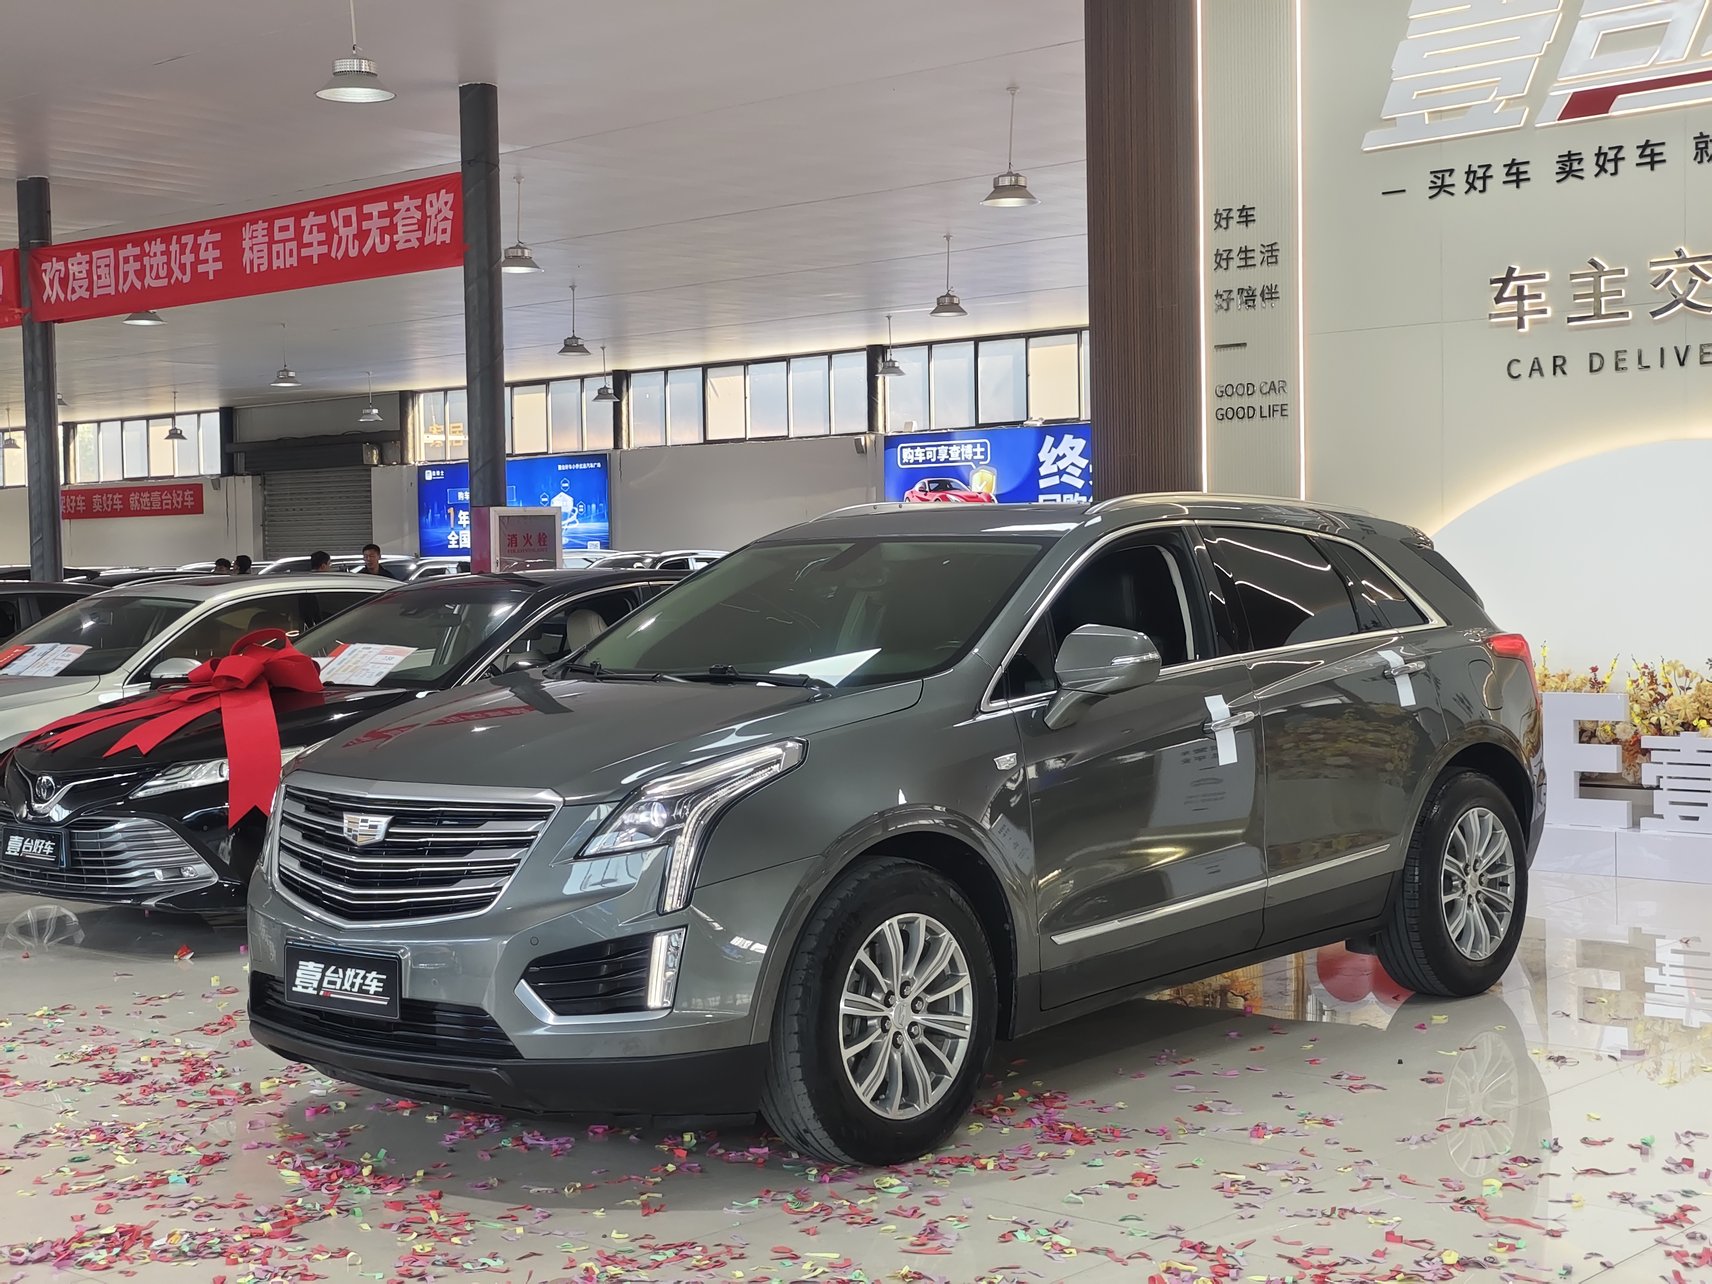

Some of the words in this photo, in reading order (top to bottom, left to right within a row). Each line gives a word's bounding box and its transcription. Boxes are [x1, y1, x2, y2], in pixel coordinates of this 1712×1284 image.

[1428, 158, 1531, 199] 买好车
[1555, 139, 1666, 183] 卖好车
[1213, 204, 1256, 231] 好车
[41, 229, 223, 304] 欢度国庆选好车
[242, 188, 455, 275] 精品车况无套路
[1213, 241, 1280, 271] 好生活
[1213, 283, 1281, 311] 好陪伴
[1488, 246, 1712, 332] 车主交
[1506, 354, 1568, 380] CAR
[1214, 382, 1256, 398] GOOD
[1259, 380, 1287, 396] CAR
[1215, 405, 1256, 421] GOOD
[1259, 403, 1289, 419] LIFE
[902, 444, 985, 463] 购车可享查博士
[1038, 434, 1089, 489] 终
[507, 532, 548, 548] 消火栓
[6, 835, 55, 857] 壹台好车
[291, 960, 387, 995] 壹台好车
